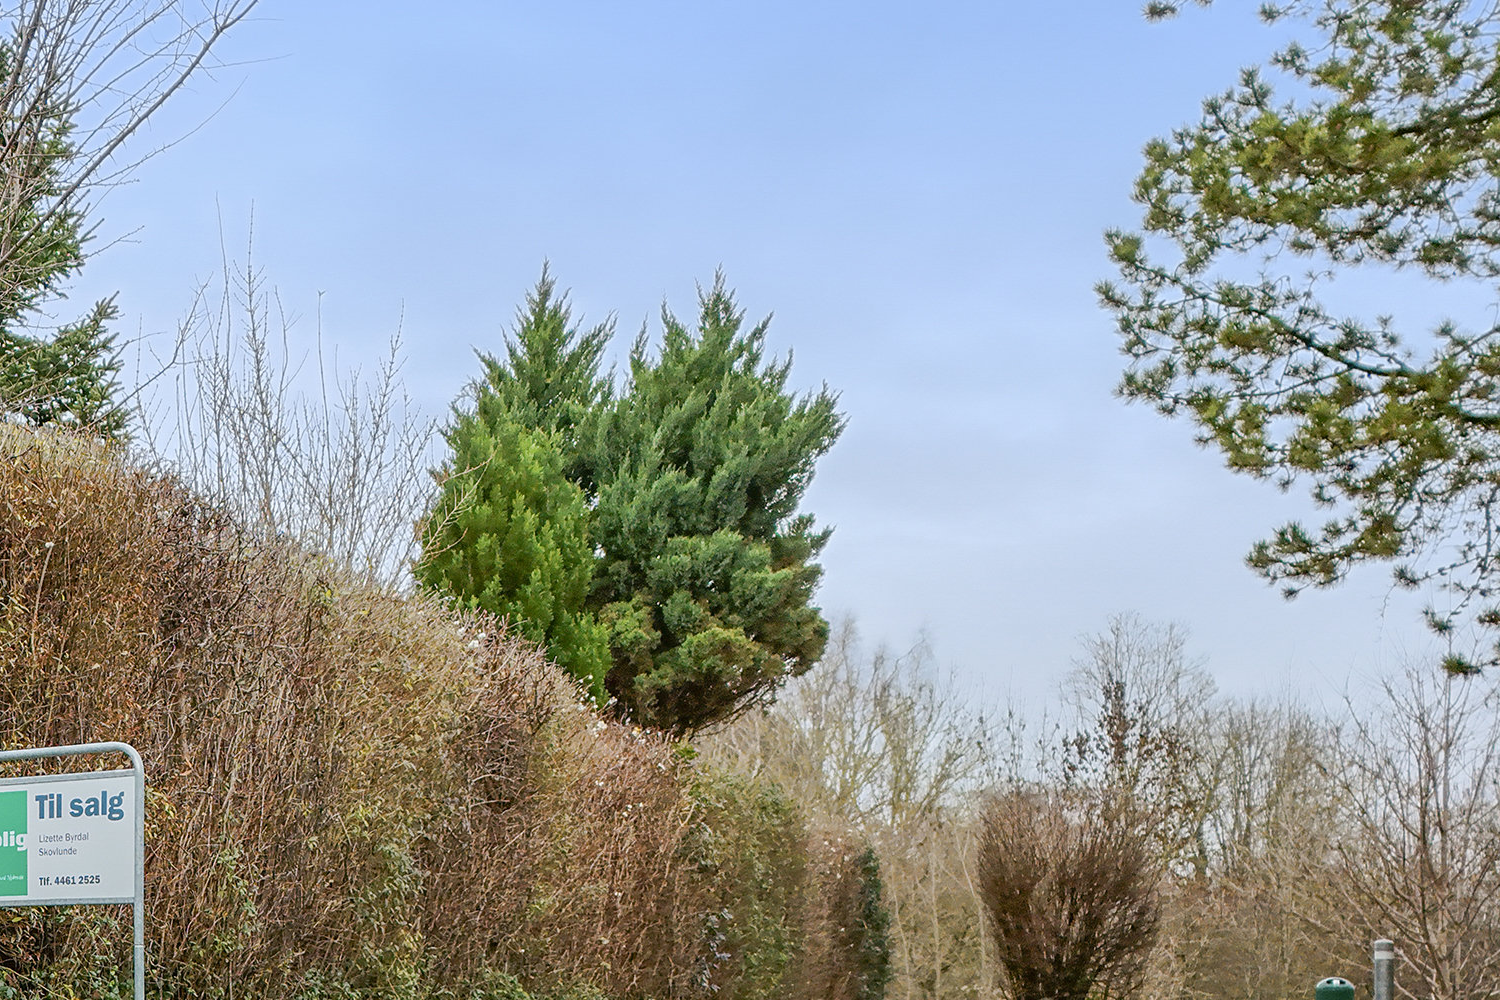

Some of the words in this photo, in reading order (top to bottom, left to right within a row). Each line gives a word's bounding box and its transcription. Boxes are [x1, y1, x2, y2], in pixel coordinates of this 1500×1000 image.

[35, 793, 62, 819] Til
[69, 791, 125, 821] salg
[39, 834, 63, 843] Lizette
[65, 832, 89, 842] Byrdal
[38, 847, 77, 856] Skovlunde
[39, 877, 52, 886] Tlf.
[54, 876, 76, 886] 4461
[78, 875, 100, 885] 2525
